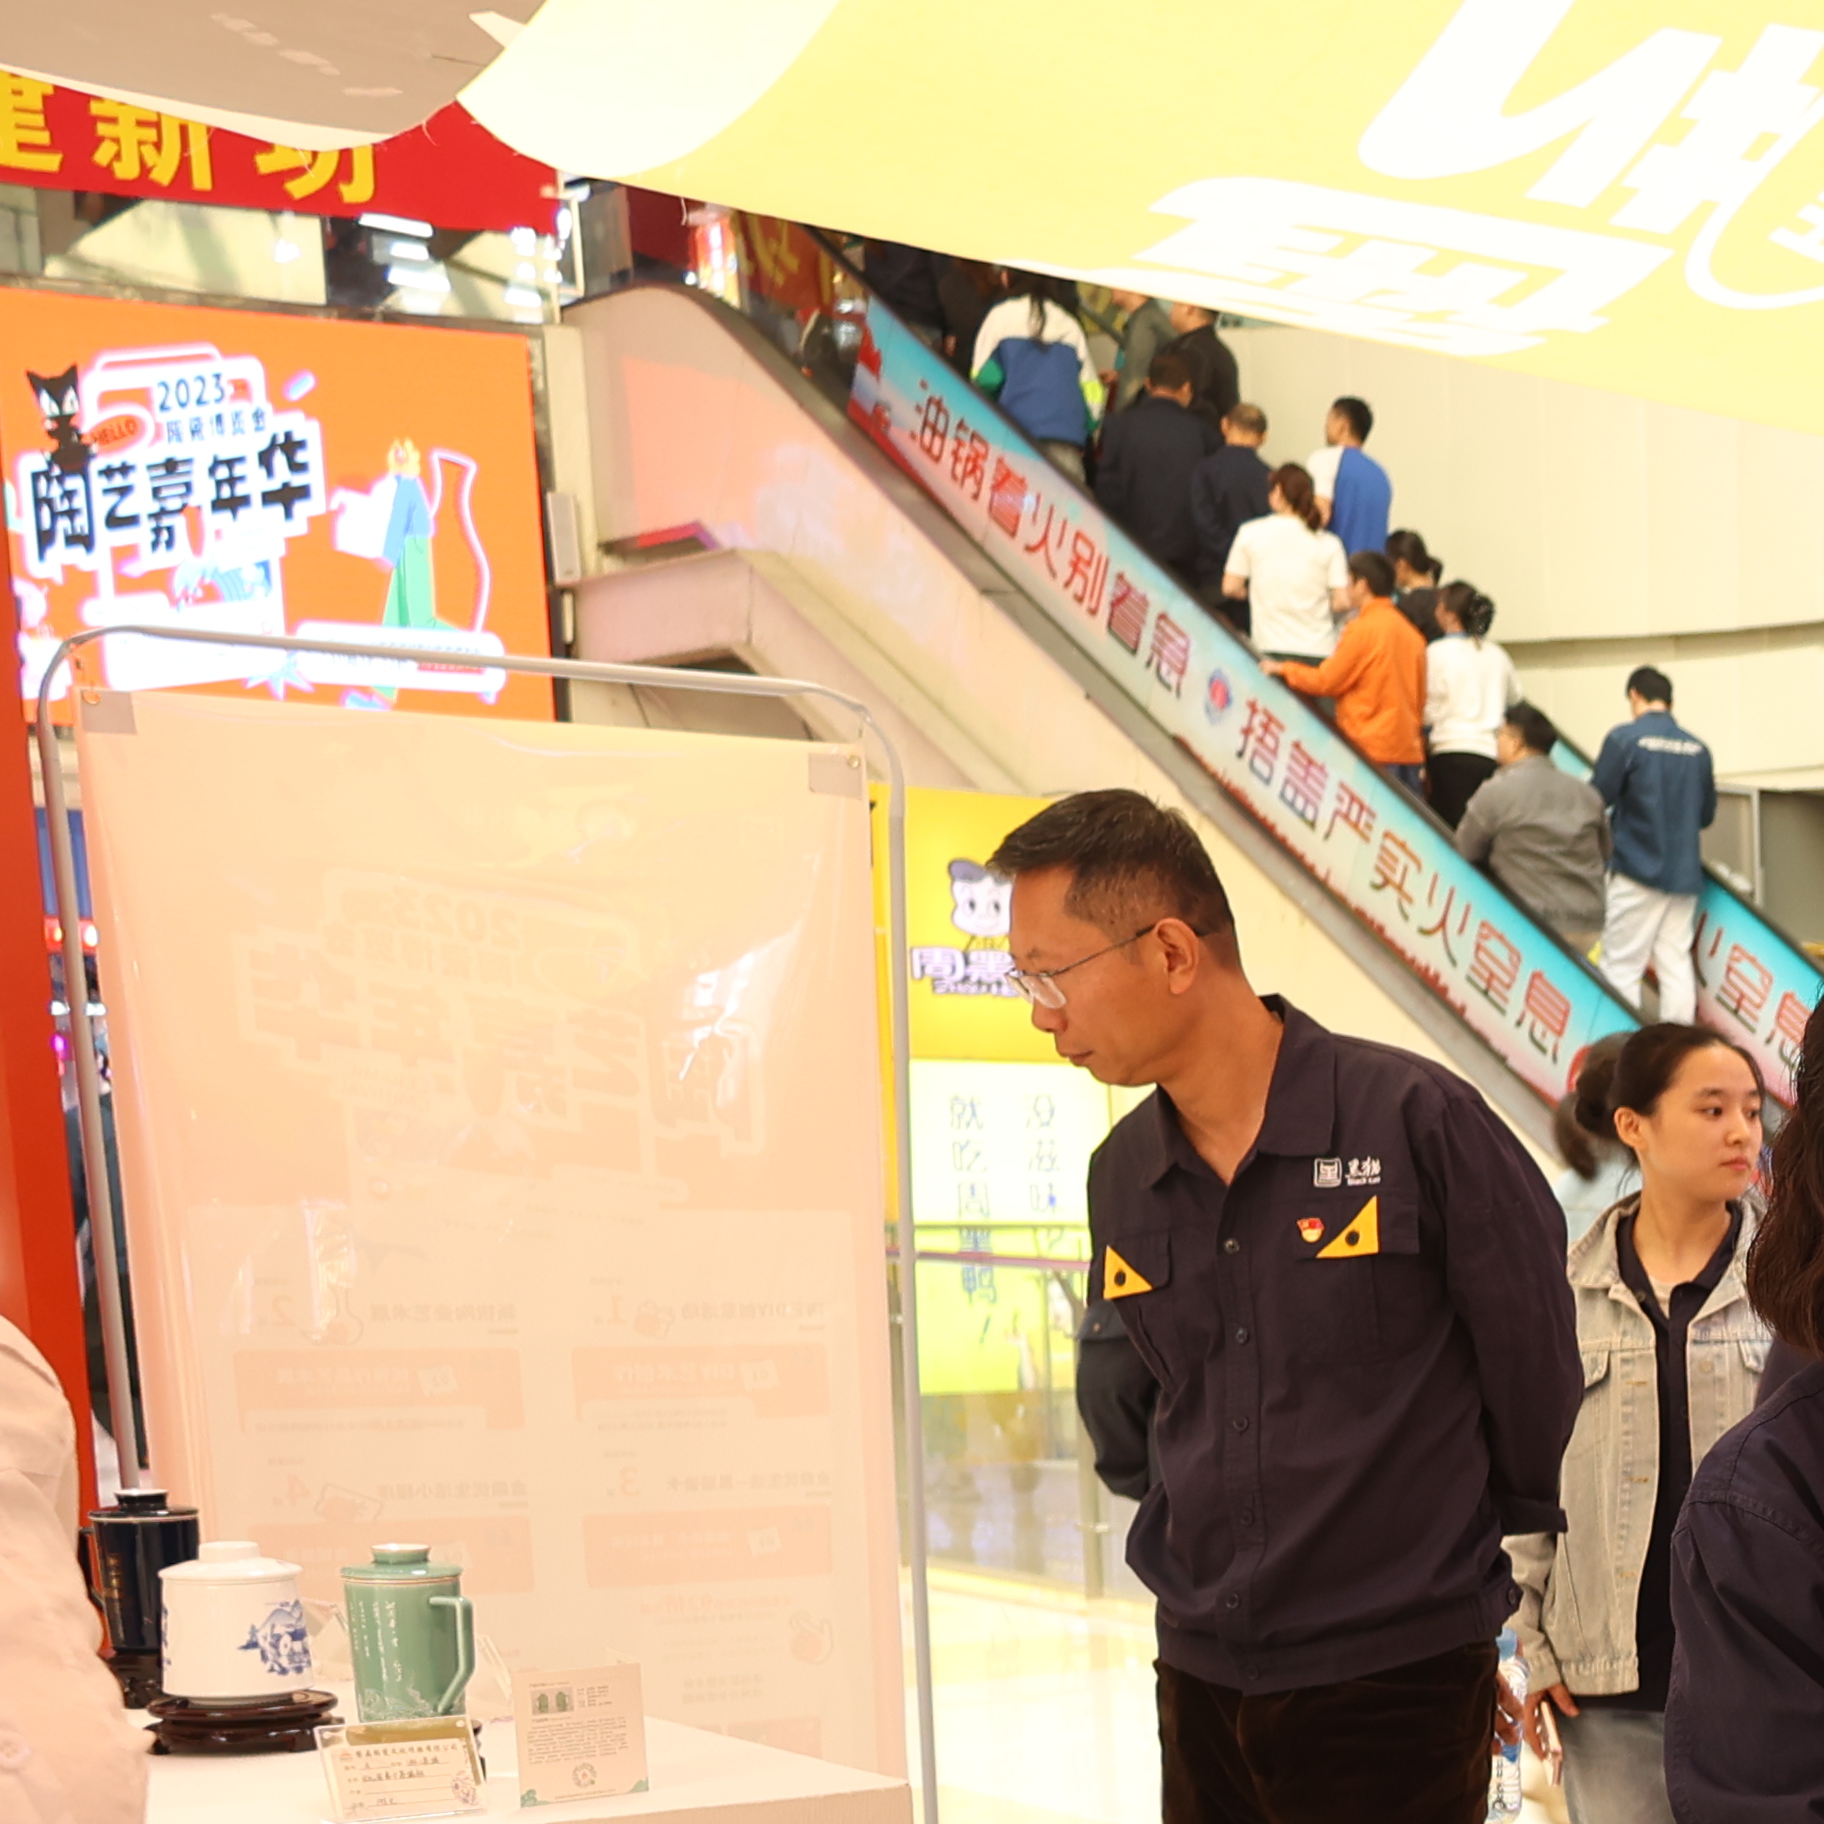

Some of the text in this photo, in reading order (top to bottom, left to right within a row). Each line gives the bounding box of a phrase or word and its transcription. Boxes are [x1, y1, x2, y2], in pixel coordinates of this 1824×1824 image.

[30, 430, 312, 563] 陶艺嘉年华
[157, 373, 226, 413] 2023
[908, 378, 1192, 700] 油锅着火别着急
[1236, 699, 1571, 1065] 捂盖严实火窒息
